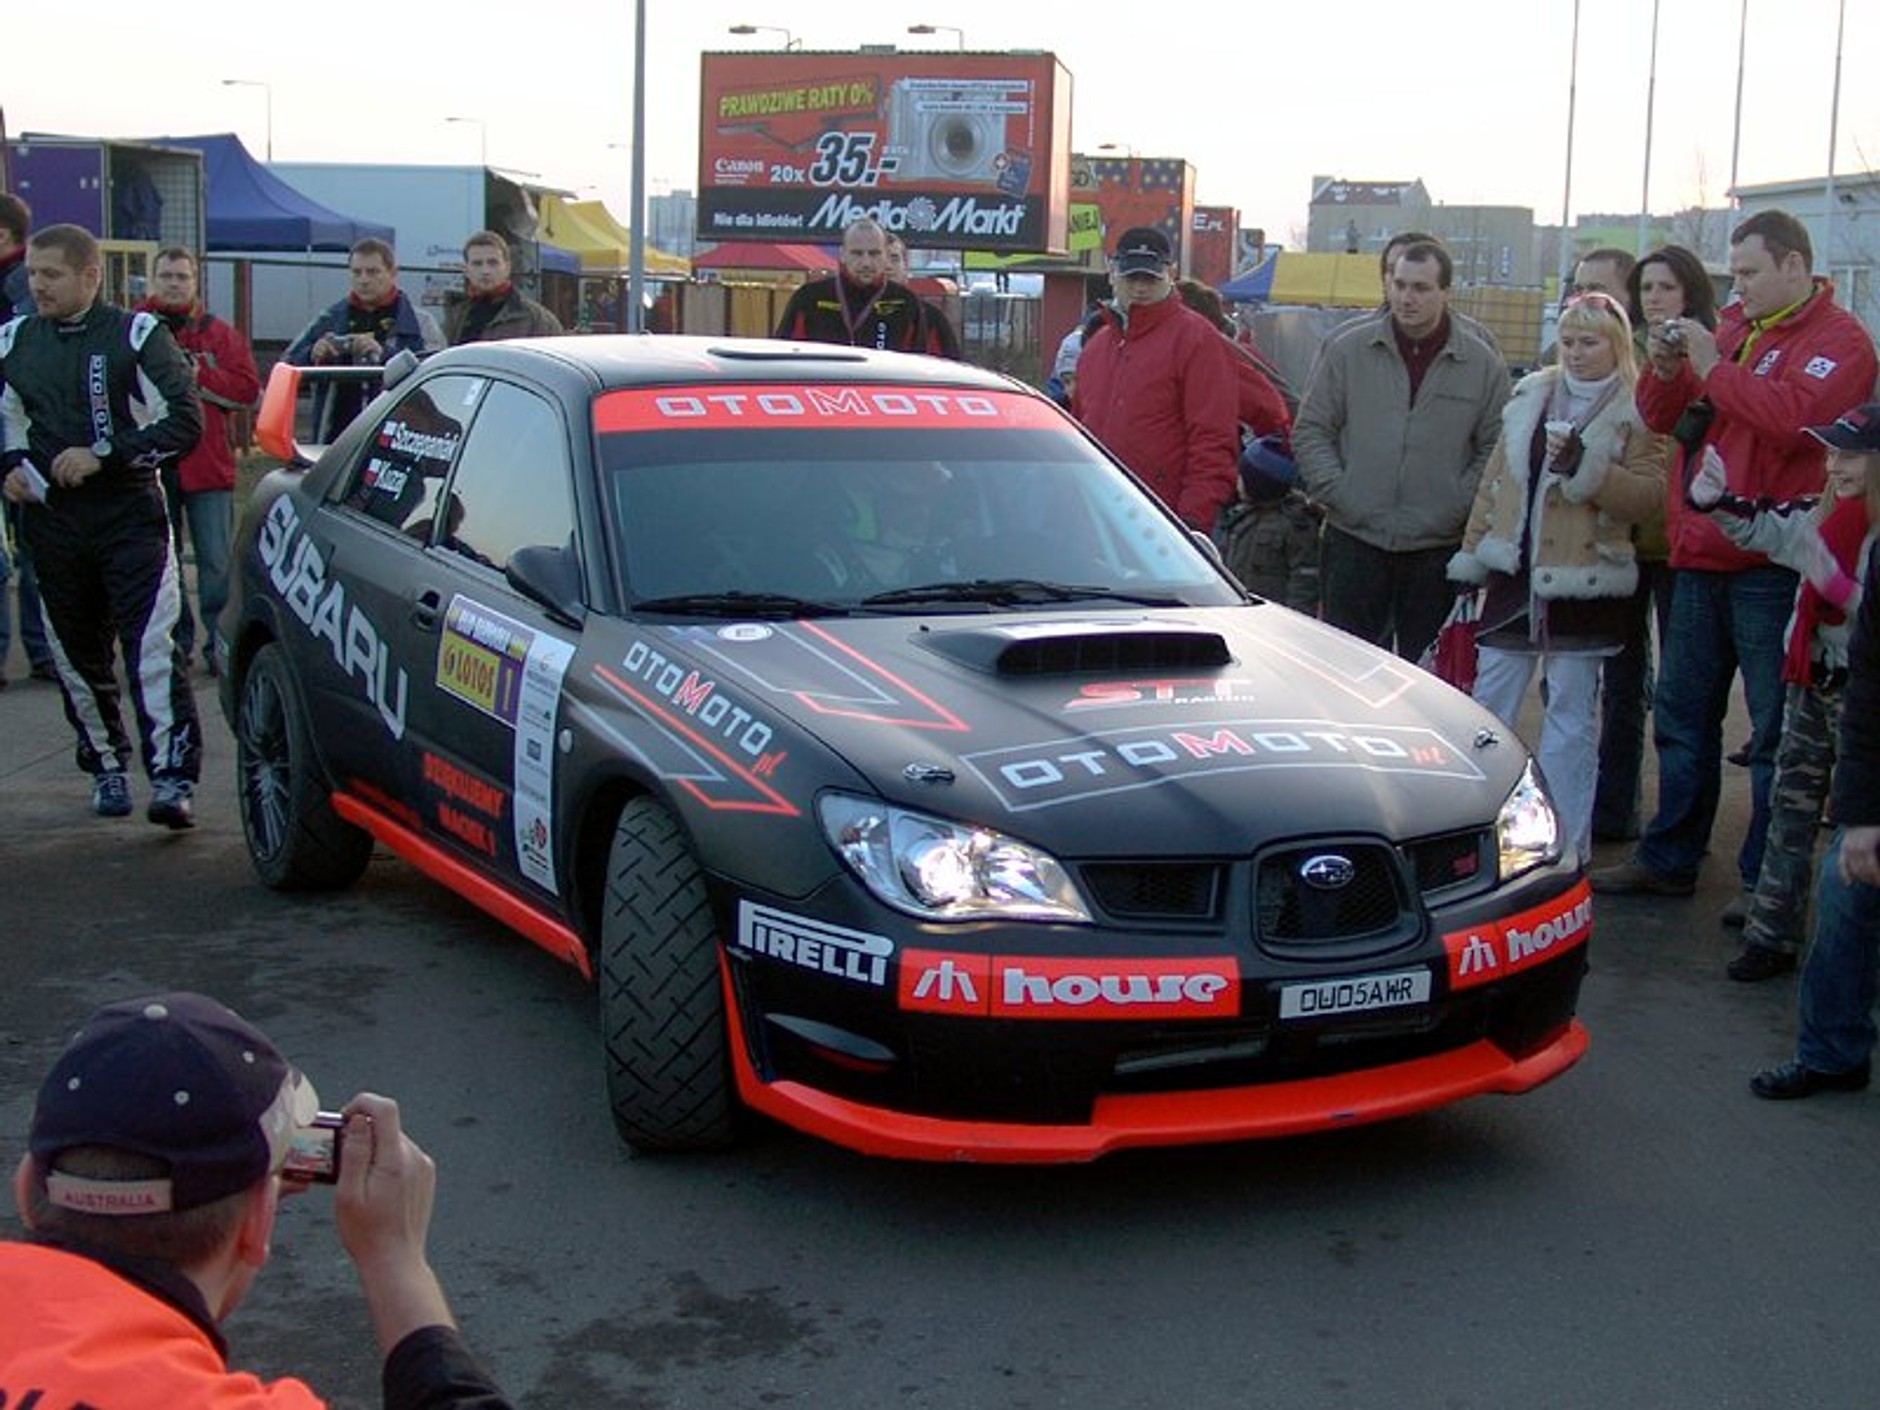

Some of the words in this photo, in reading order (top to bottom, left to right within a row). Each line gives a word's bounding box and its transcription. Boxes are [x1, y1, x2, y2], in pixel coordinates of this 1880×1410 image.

[719, 88, 805, 118] PRAWDZIWE
[808, 85, 847, 109] RATY
[715, 158, 764, 173] Canon
[771, 165, 805, 183] 20x
[713, 212, 734, 226] Nie
[735, 213, 754, 227] dla
[809, 194, 908, 231] Media
[931, 198, 1025, 234] Markt
[91, 355, 113, 442] OTOMOT
[656, 388, 998, 416] OTOMOTO
[258, 493, 408, 741] SUBARU
[456, 648, 495, 699] LOTOS
[738, 899, 894, 986] PIRELLI
[1003, 968, 1229, 1005] house
[64, 1189, 154, 1208] AUSTRALIA
